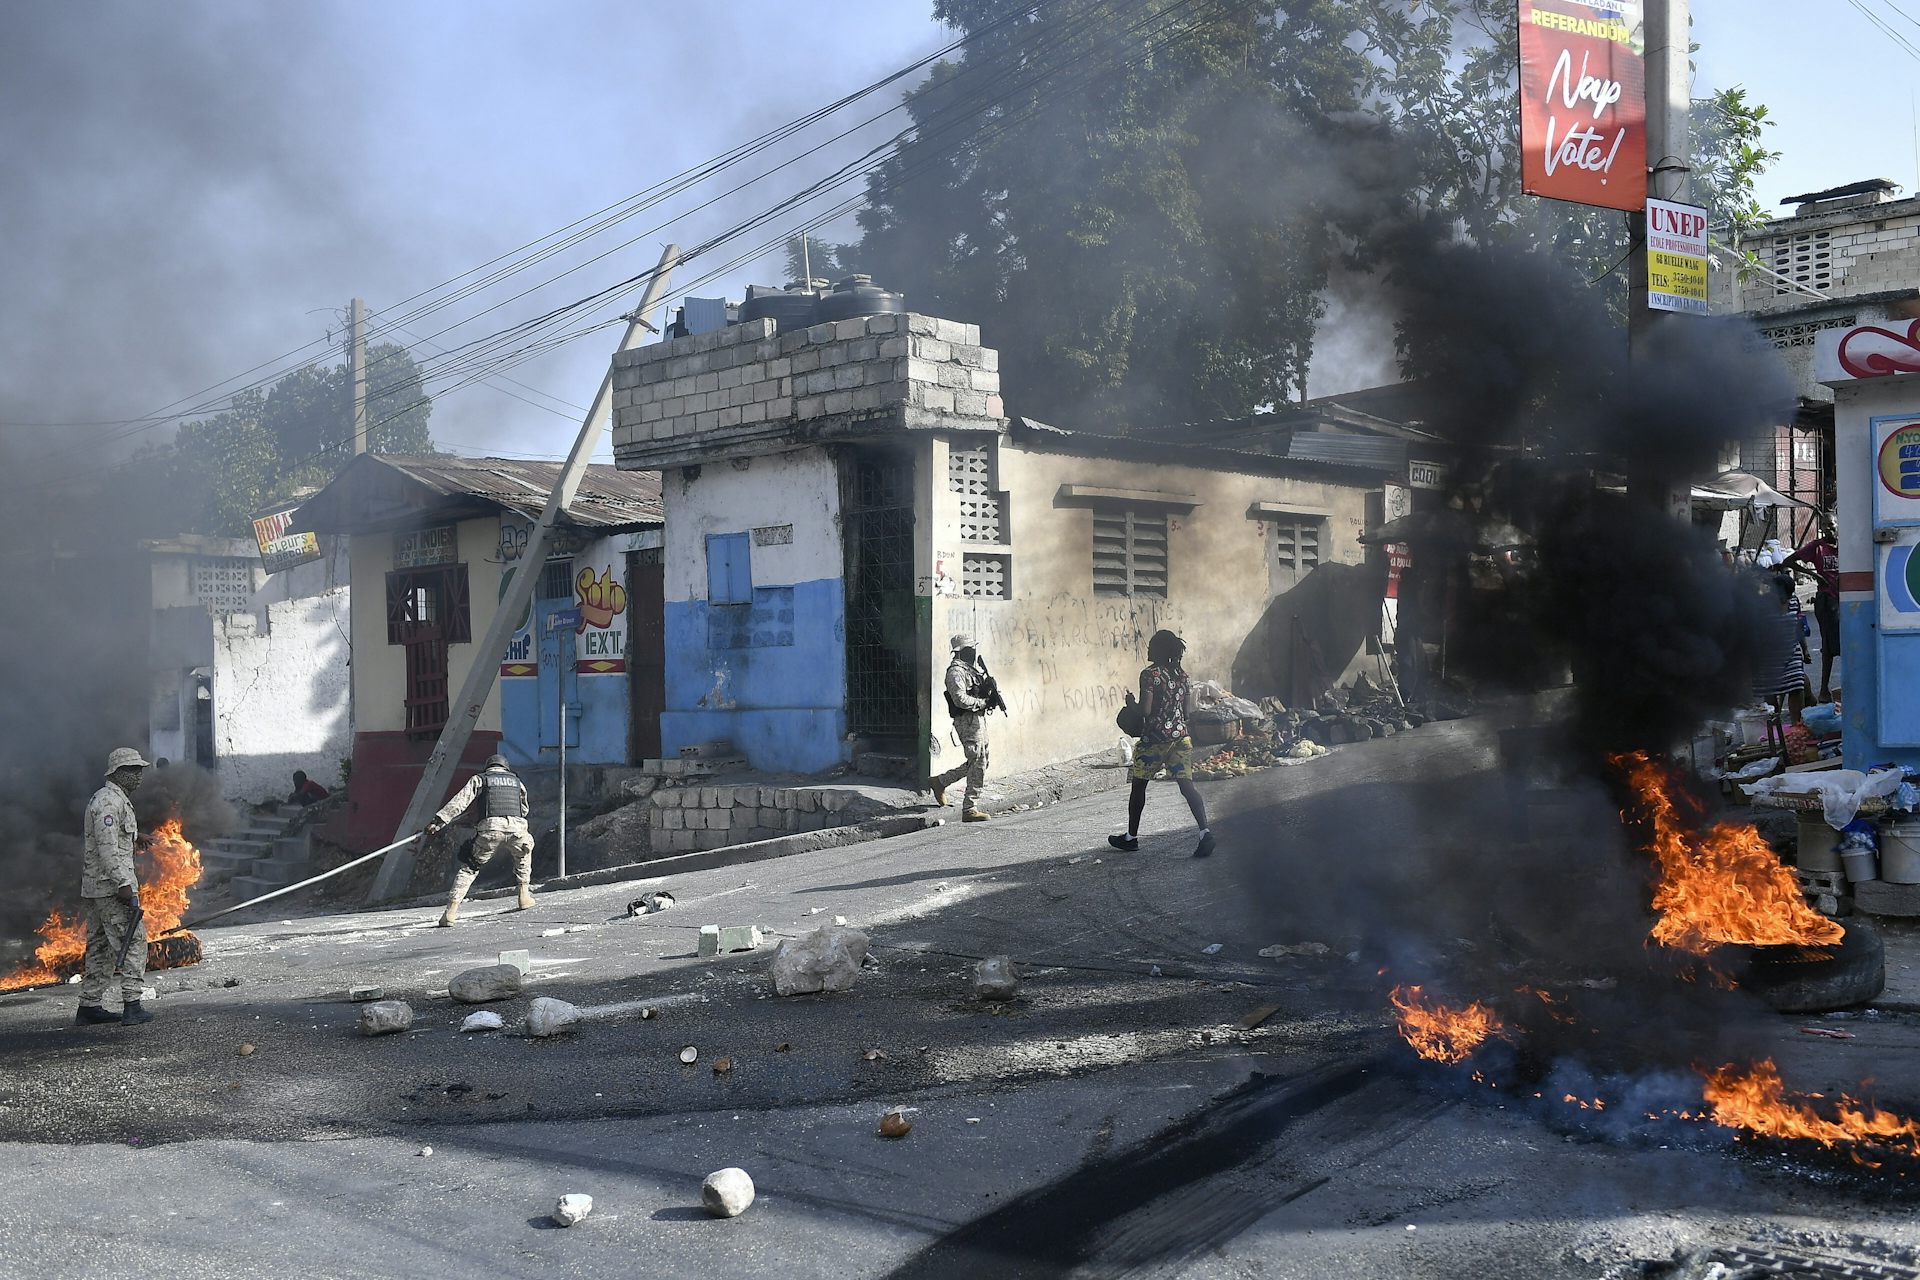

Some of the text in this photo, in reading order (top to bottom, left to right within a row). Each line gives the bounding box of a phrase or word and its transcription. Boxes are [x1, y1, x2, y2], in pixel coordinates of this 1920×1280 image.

[1545, 48, 1622, 119] Nap
[1544, 115, 1626, 186] Vote!
[1650, 206, 1705, 239] UNEP
[1650, 235, 1664, 250] ECOLE
[575, 564, 627, 618] Loto
[488, 777, 518, 787] POLICE
